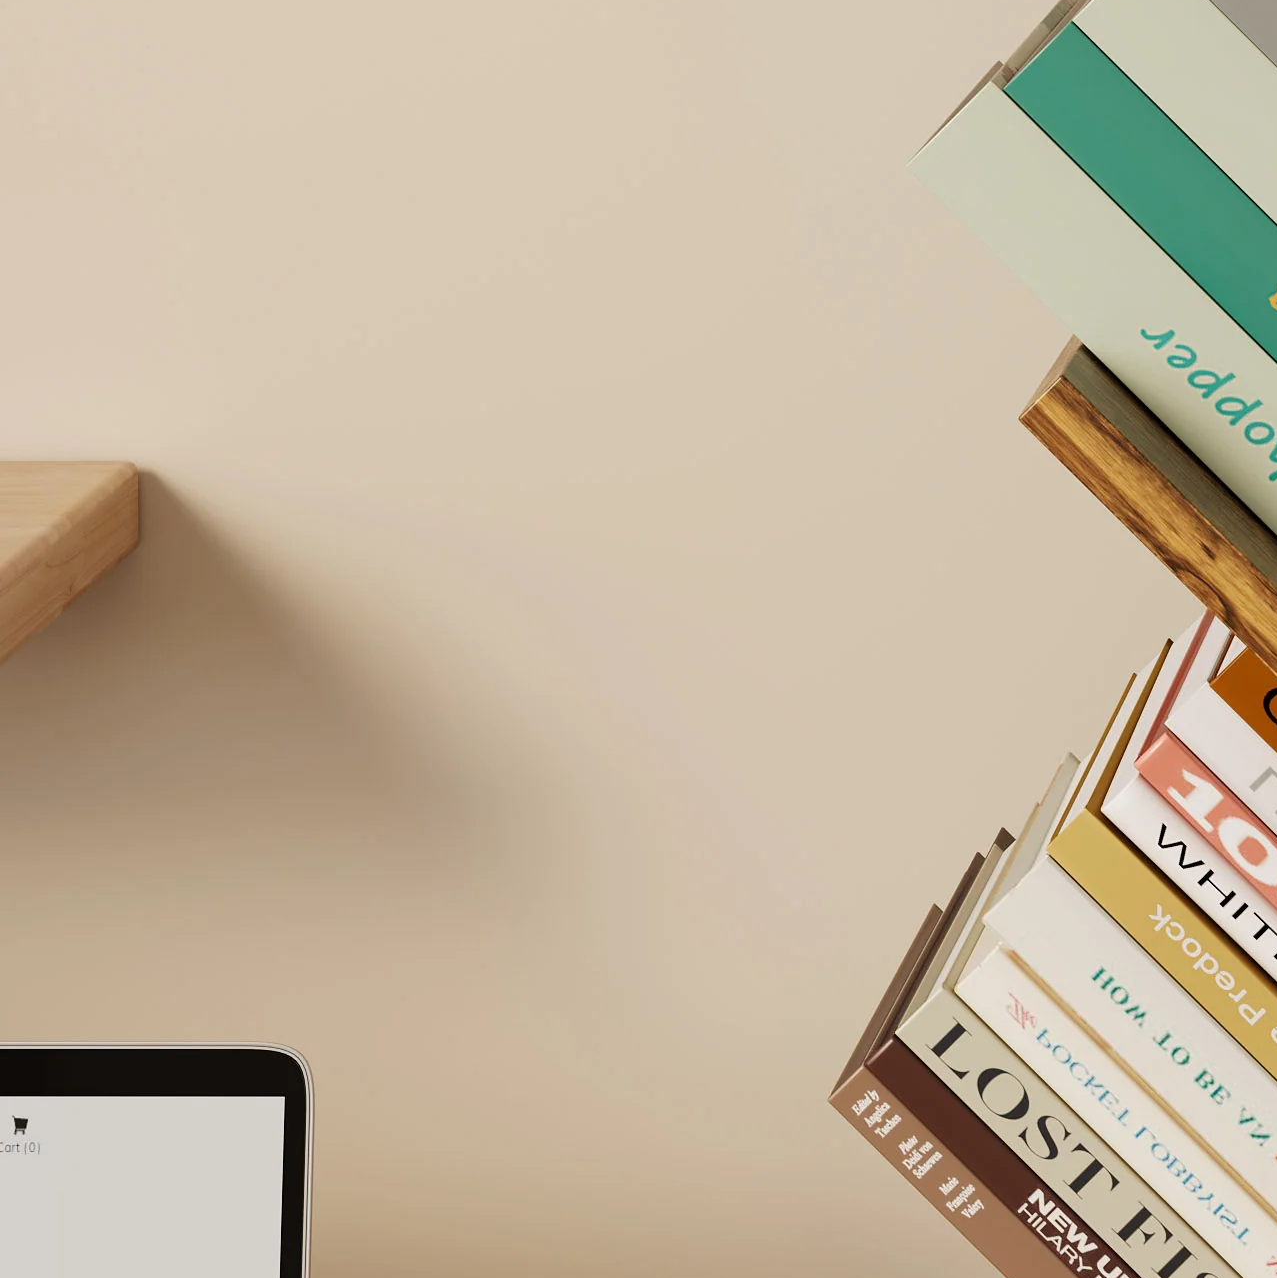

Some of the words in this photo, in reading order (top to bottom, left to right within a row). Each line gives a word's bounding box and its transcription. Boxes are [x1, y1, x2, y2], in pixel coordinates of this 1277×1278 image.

[1148, 902, 1266, 1024] Predock
[925, 1018, 1120, 1200] LOST
[1016, 1203, 1093, 1273] HILARY
[1027, 1189, 1098, 1254] NEW
